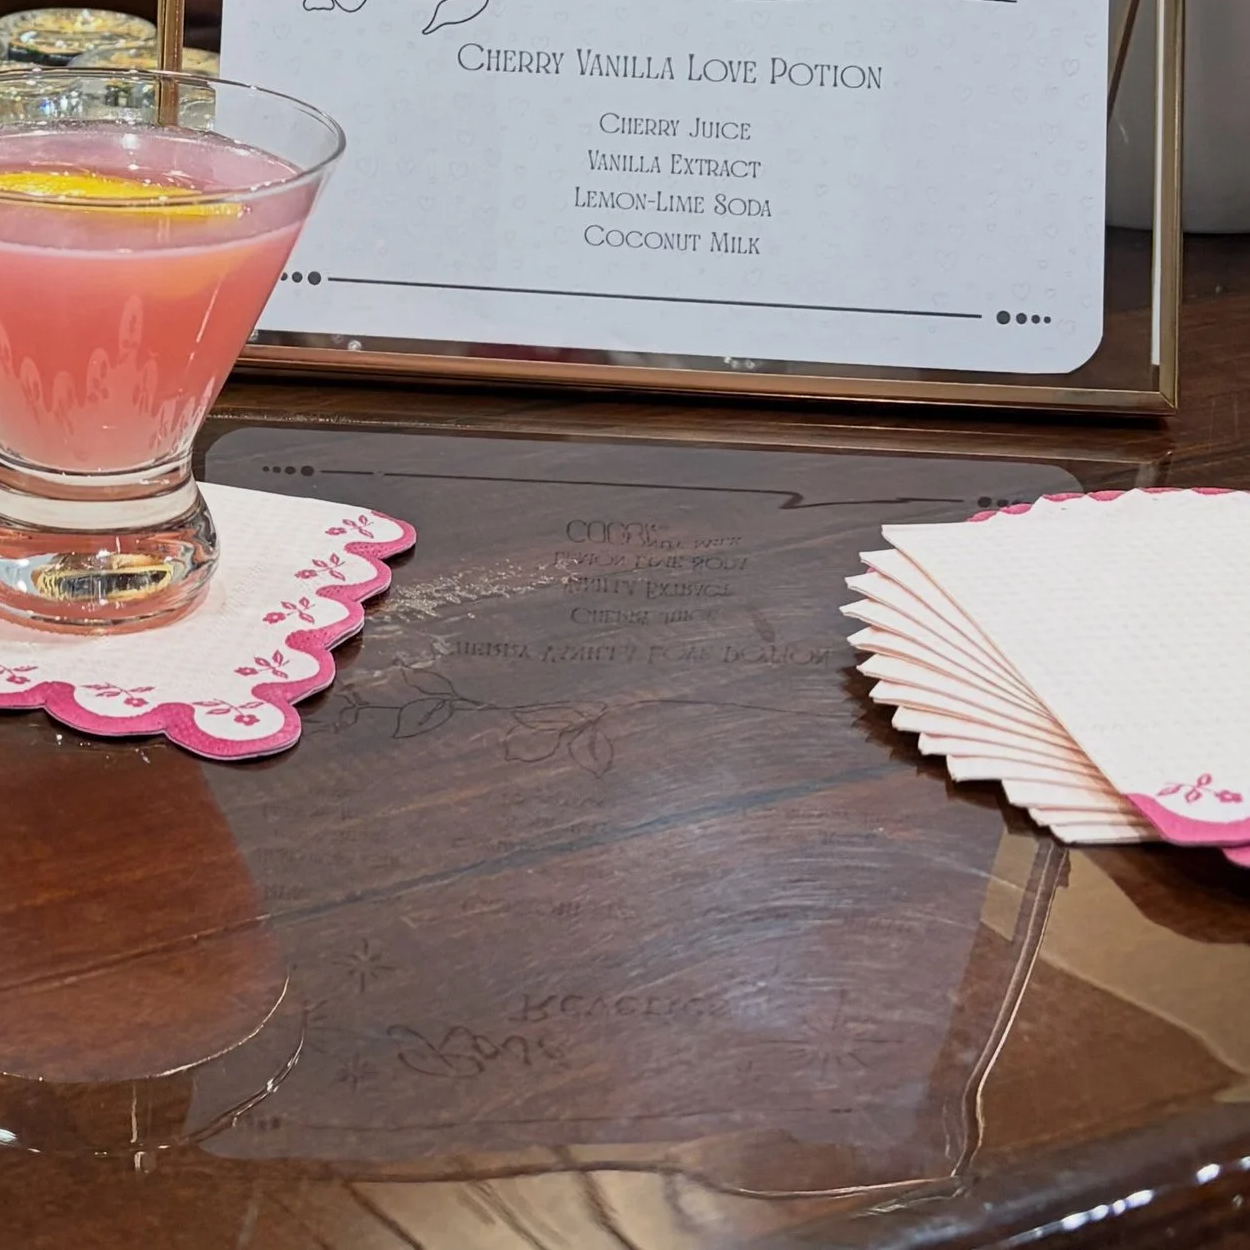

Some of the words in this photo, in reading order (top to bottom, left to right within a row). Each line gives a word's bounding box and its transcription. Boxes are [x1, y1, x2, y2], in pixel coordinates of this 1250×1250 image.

[457, 42, 565, 75] CHERRY
[576, 48, 675, 81] VANILLA
[687, 53, 757, 84] LOVE
[769, 57, 883, 90] POTION
[599, 112, 680, 137] CHERRY
[688, 117, 751, 141] JUICE
[587, 149, 661, 174] VANILLA
[670, 153, 762, 179] EXTRACT
[574, 185, 705, 214] LEMON-LIME
[713, 193, 772, 218] SODA
[583, 224, 702, 252] COCONUT
[709, 231, 761, 255] MILK
